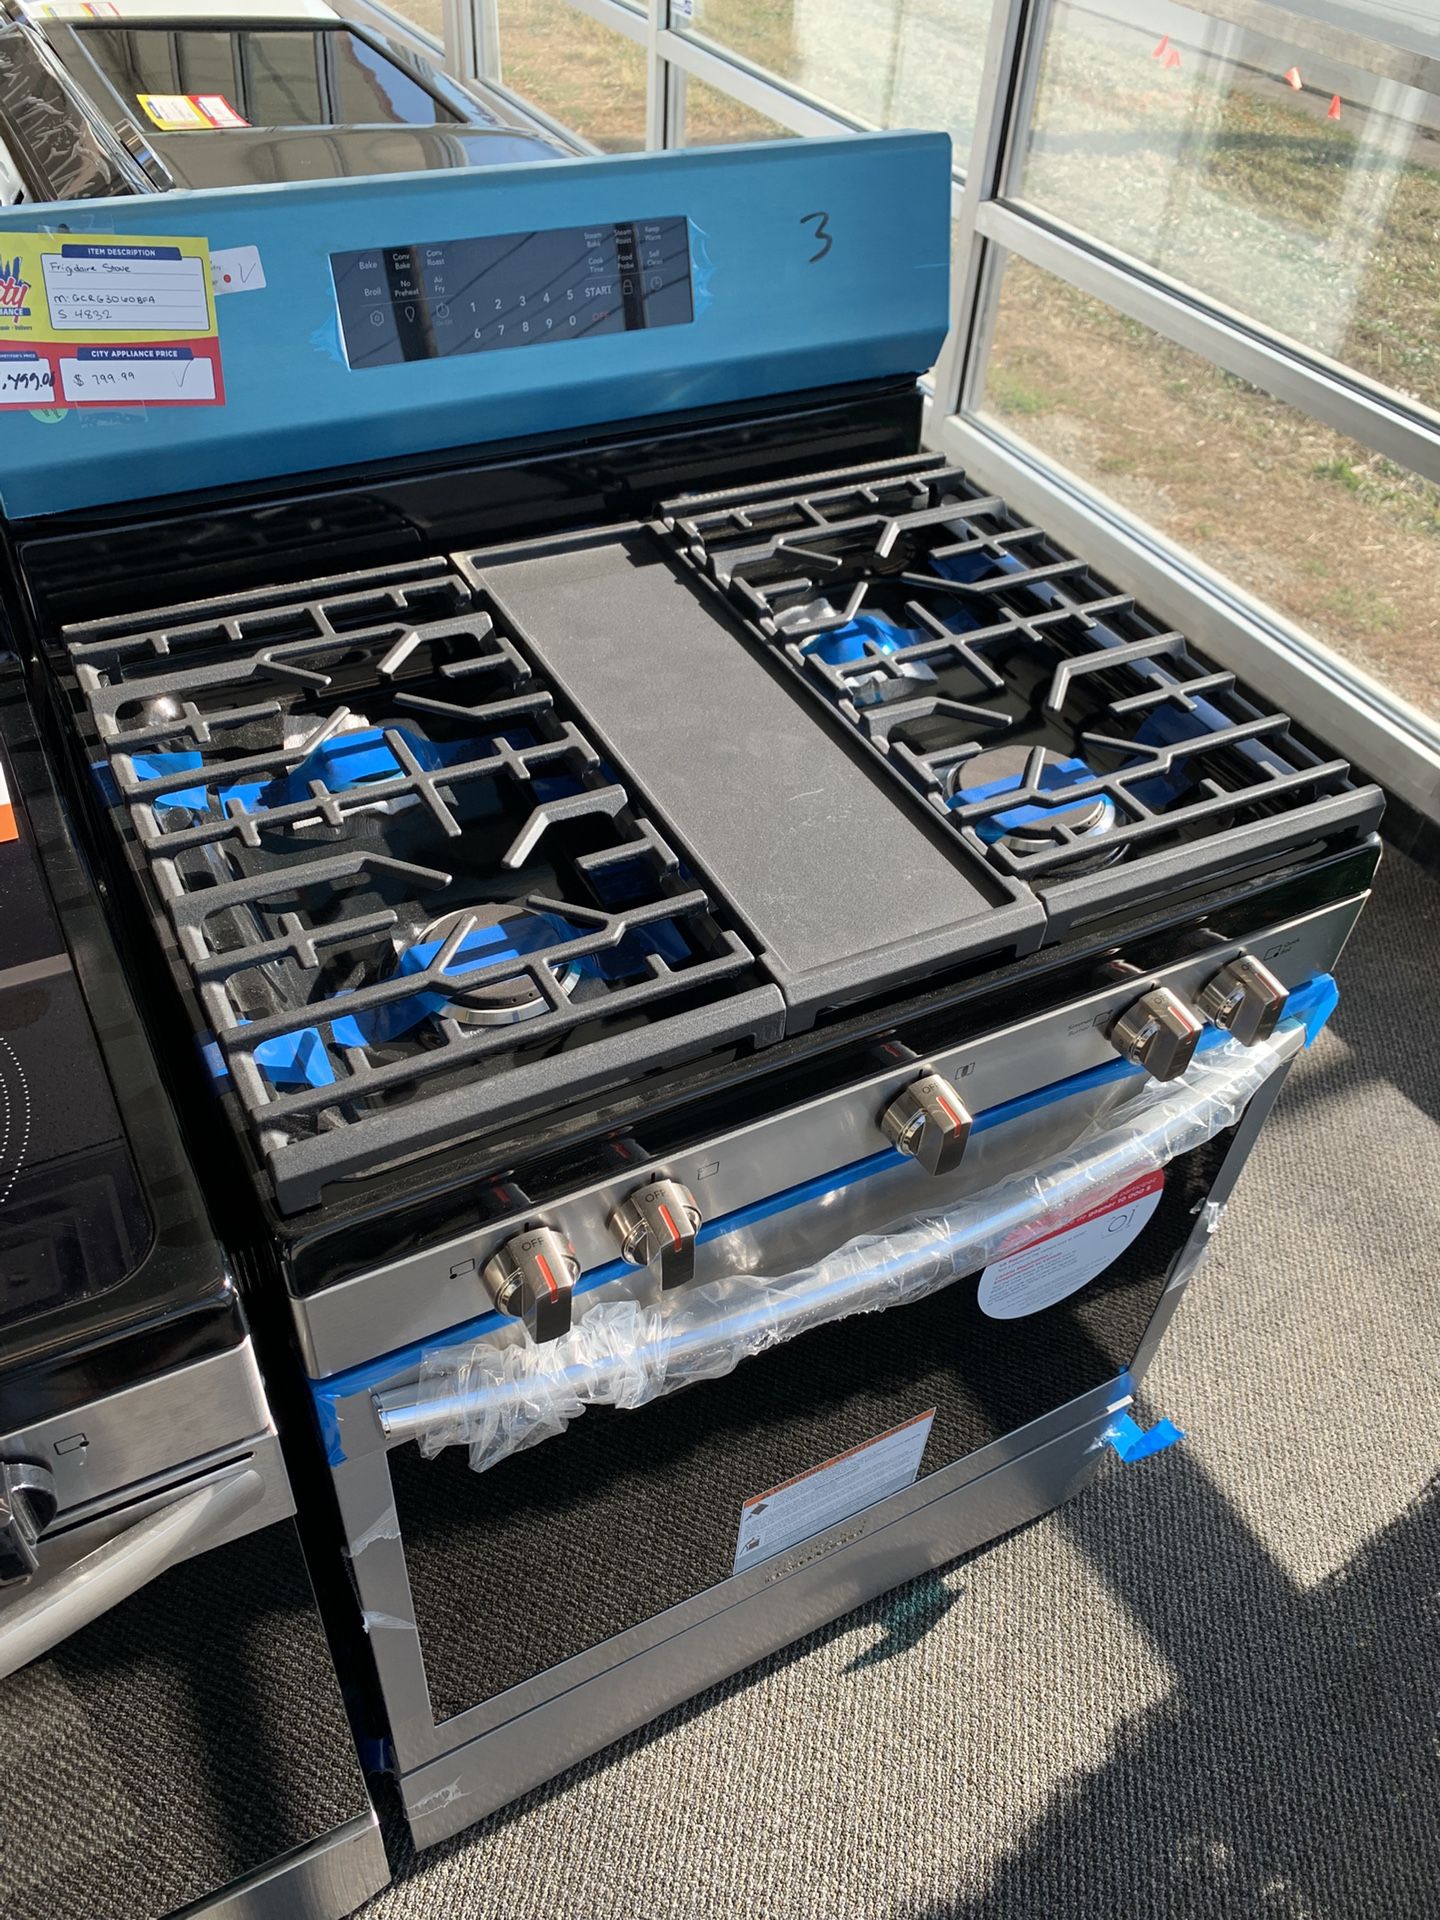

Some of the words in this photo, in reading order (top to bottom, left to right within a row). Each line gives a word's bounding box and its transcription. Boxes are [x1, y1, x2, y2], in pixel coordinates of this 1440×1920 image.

[800, 211, 832, 264] 3
[107, 248, 156, 256] DESCRIPTION
[426, 249, 443, 257] Conv
[393, 253, 410, 261] Conv
[427, 257, 445, 266] Roast
[588, 257, 604, 265] Cook
[102, 263, 131, 273] Stove
[359, 261, 378, 270] Bake
[394, 262, 411, 270] Bake
[400, 280, 411, 288] No
[433, 276, 444, 284] Air
[364, 287, 382, 297] Broil
[394, 288, 420, 297] Preheat
[434, 285, 446, 294] Fry
[584, 285, 612, 298] START
[0, 277, 28, 324] ty
[470, 302, 476, 312] 1
[494, 298, 502, 310] 2
[519, 295, 526, 306] 3
[543, 292, 550, 303] 4
[567, 289, 574, 301] 5
[0, 308, 24, 316] IANCE
[74, 308, 113, 321] 4832
[592, 311, 609, 322] OFF
[474, 328, 481, 339] 6
[498, 324, 505, 335] 7
[522, 321, 529, 333] 8
[546, 318, 553, 329] 9
[569, 315, 576, 326] 0
[91, 350, 109, 358] CITY
[111, 350, 155, 358] APPLIANCE
[156, 350, 178, 358] PRICE
[73, 373, 85, 387] $
[91, 371, 135, 385] 799.99
[645, 1189, 666, 1204] OFF
[521, 1237, 545, 1251] OFF
